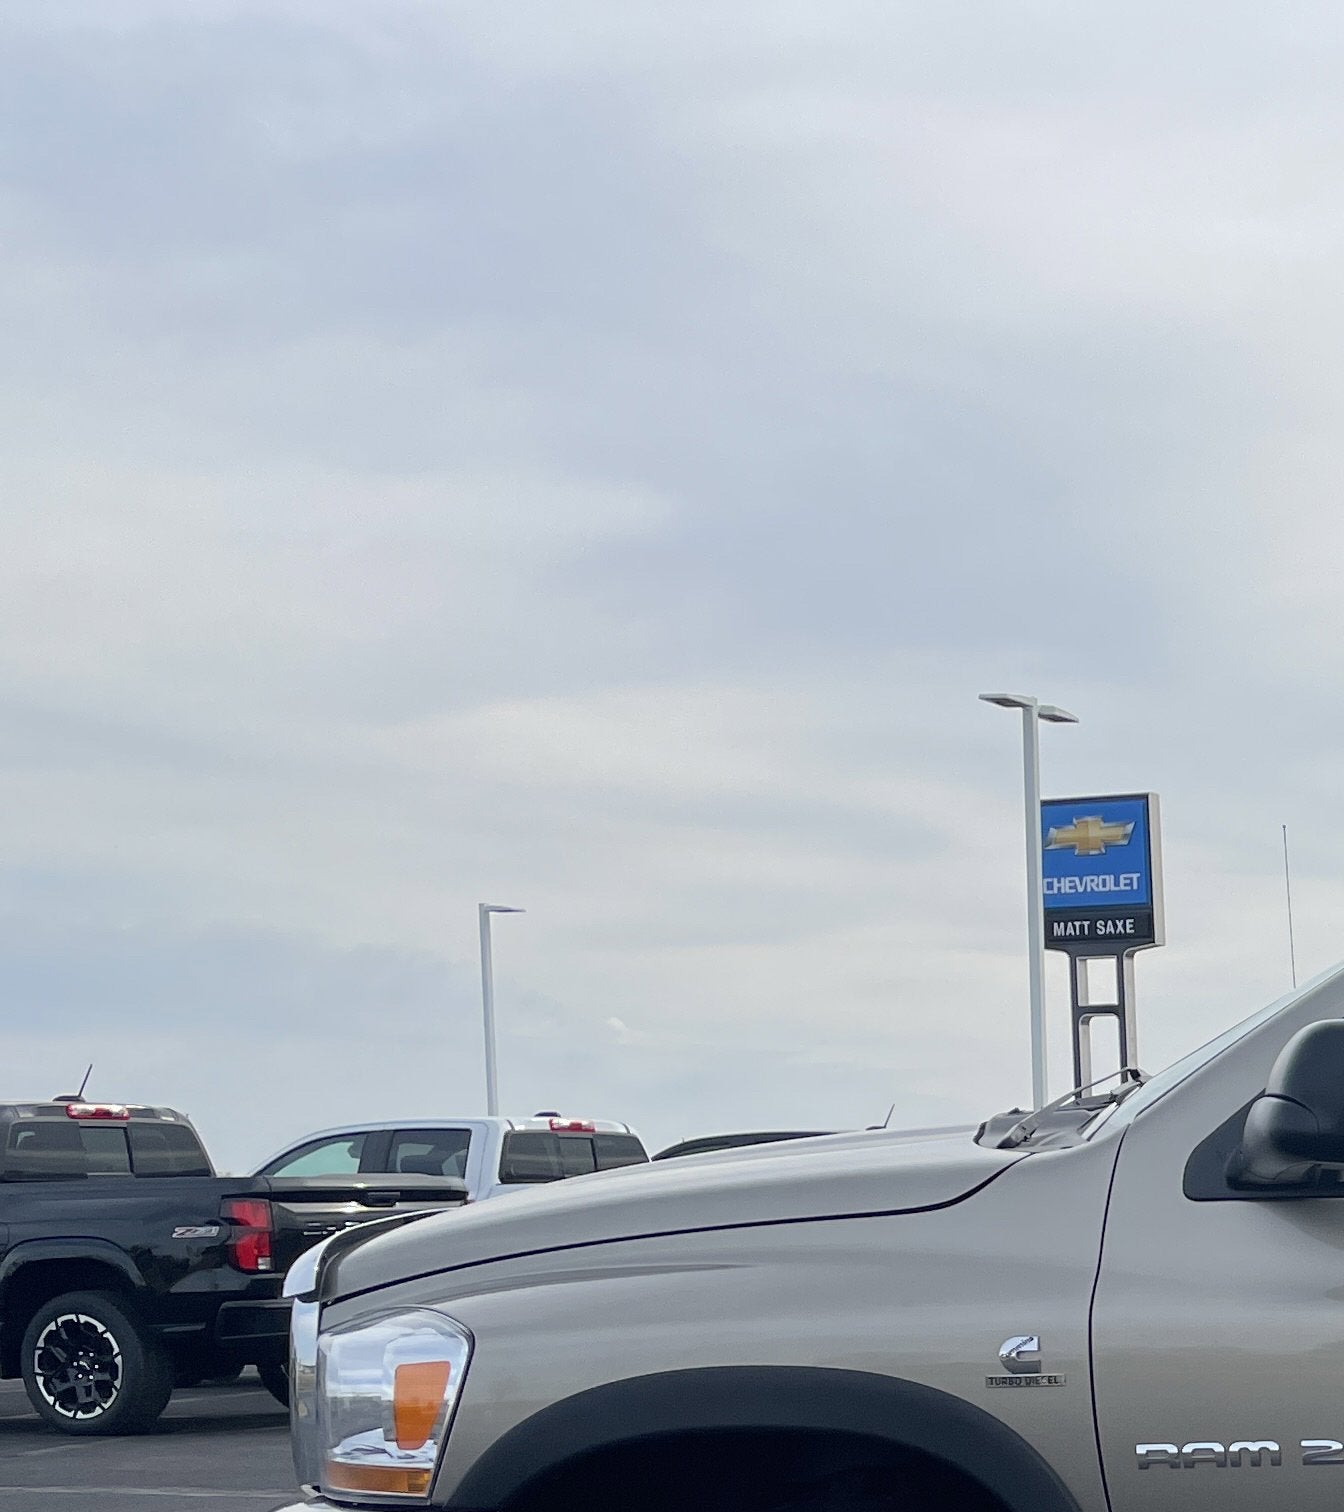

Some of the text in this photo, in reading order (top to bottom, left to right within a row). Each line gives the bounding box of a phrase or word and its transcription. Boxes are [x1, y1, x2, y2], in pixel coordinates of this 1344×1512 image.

[1043, 872, 1141, 895] CHEVROLET
[1053, 918, 1135, 937] MATT SAXE
[1135, 1440, 1283, 1470] RAM
